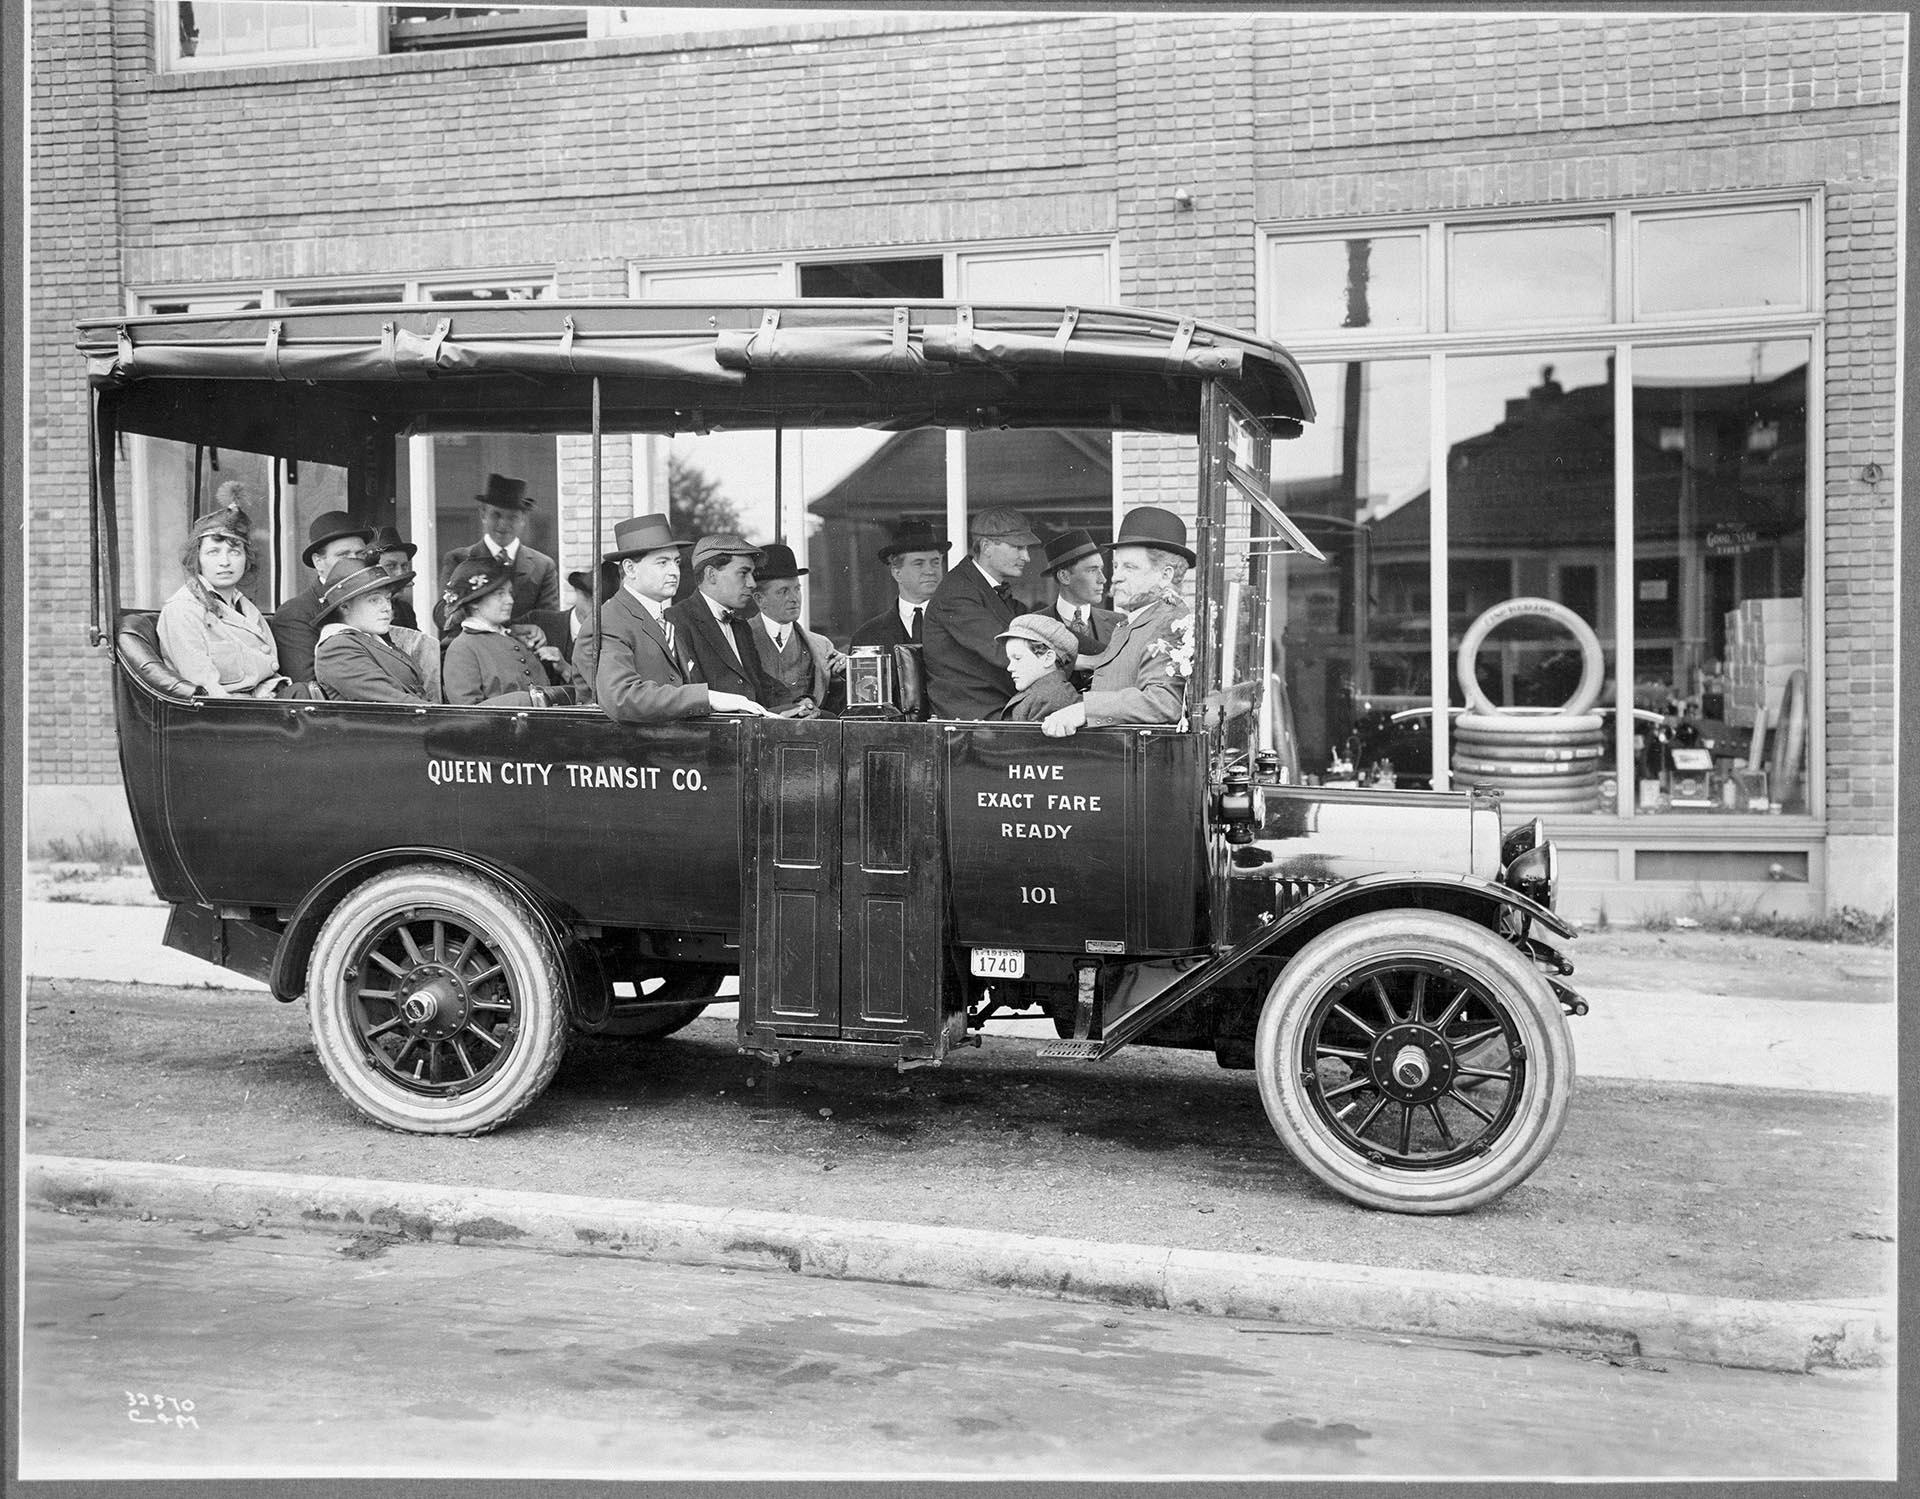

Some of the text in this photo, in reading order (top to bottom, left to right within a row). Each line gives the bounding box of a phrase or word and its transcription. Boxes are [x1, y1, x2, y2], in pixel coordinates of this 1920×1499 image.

[427, 759, 708, 792] QUEEN CITY TRANSIT CO.
[1008, 764, 1064, 781] HAVE
[977, 792, 1102, 812] EXACT FARE
[1001, 823, 1073, 840] READY
[1020, 886, 1058, 905] 101
[980, 957, 1018, 973] 1740
